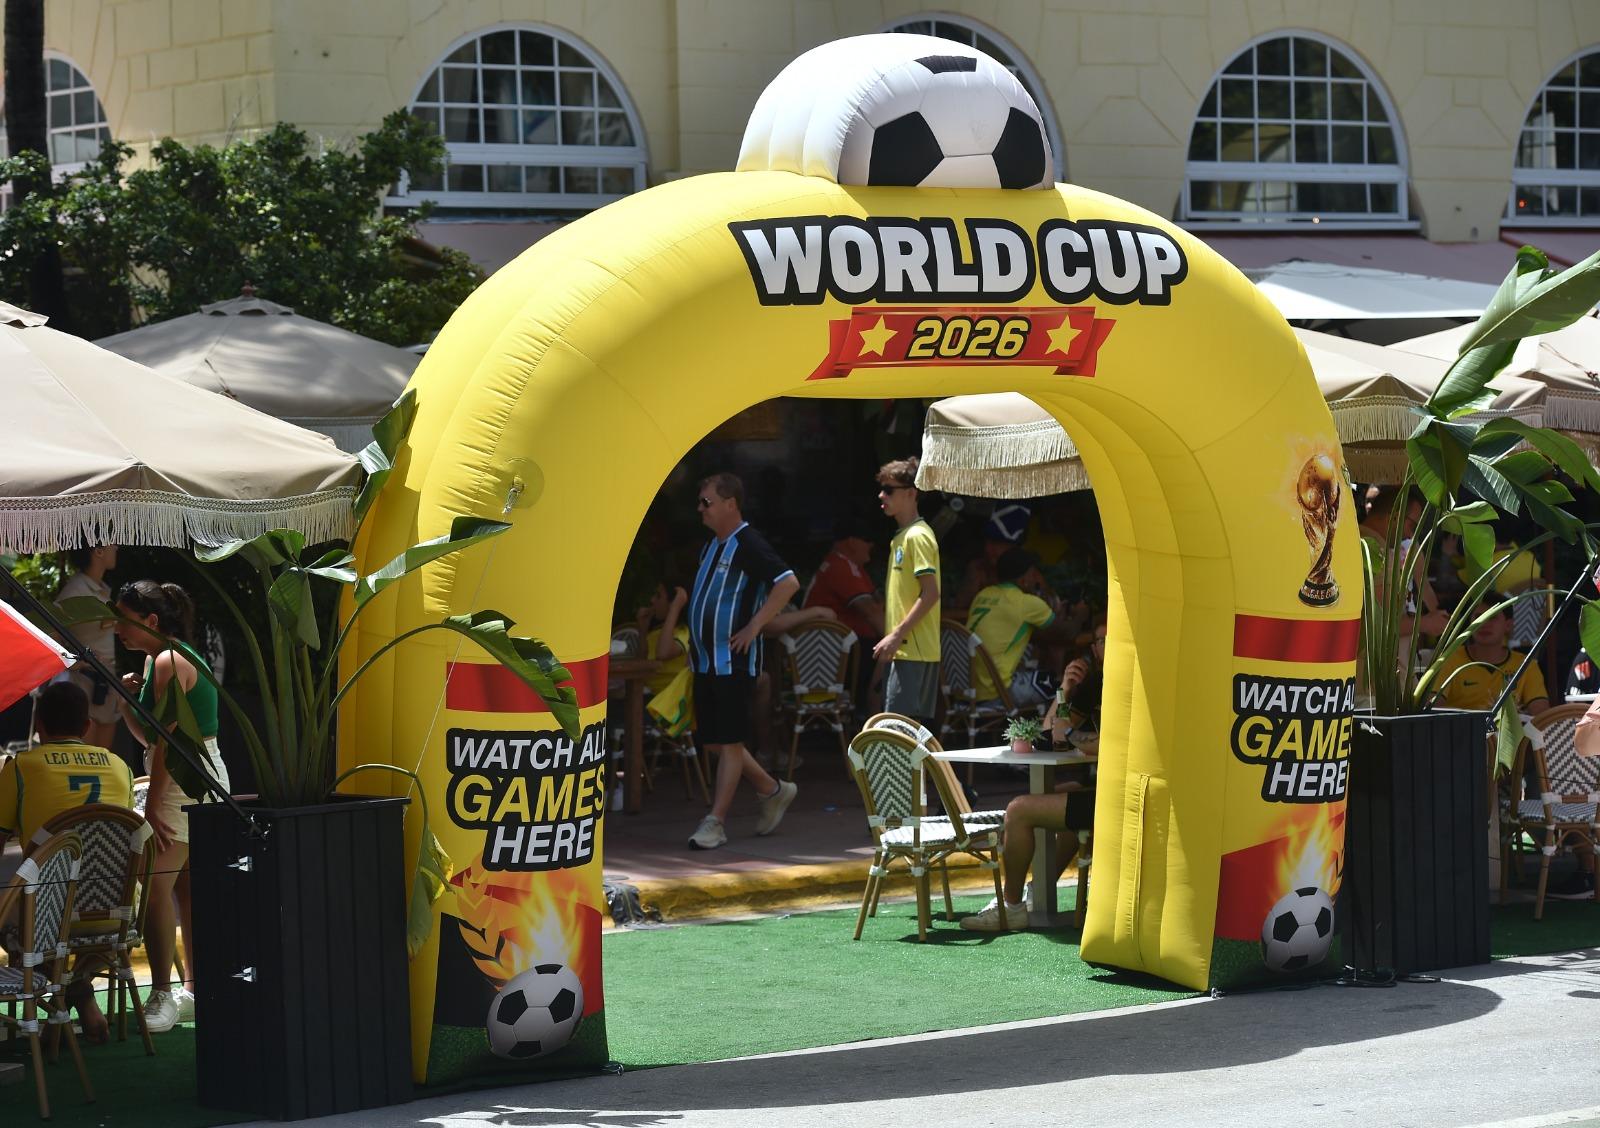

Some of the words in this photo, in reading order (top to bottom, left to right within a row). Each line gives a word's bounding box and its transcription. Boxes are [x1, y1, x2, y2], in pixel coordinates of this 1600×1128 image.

[741, 224, 1029, 295] WORLD
[1044, 226, 1183, 296] CUP
[909, 317, 1029, 359] 2026
[969, 607, 992, 632] 7
[1239, 681, 1340, 714] WATCH
[453, 735, 574, 770] WATCH
[578, 726, 606, 766] ALL
[1237, 714, 1353, 761] GAME
[44, 752, 70, 766] LEO
[72, 752, 112, 767] KLEIN
[1268, 759, 1348, 797] HERE
[68, 775, 102, 805] 7
[453, 763, 606, 823] GAMES
[490, 816, 594, 864] HERE
